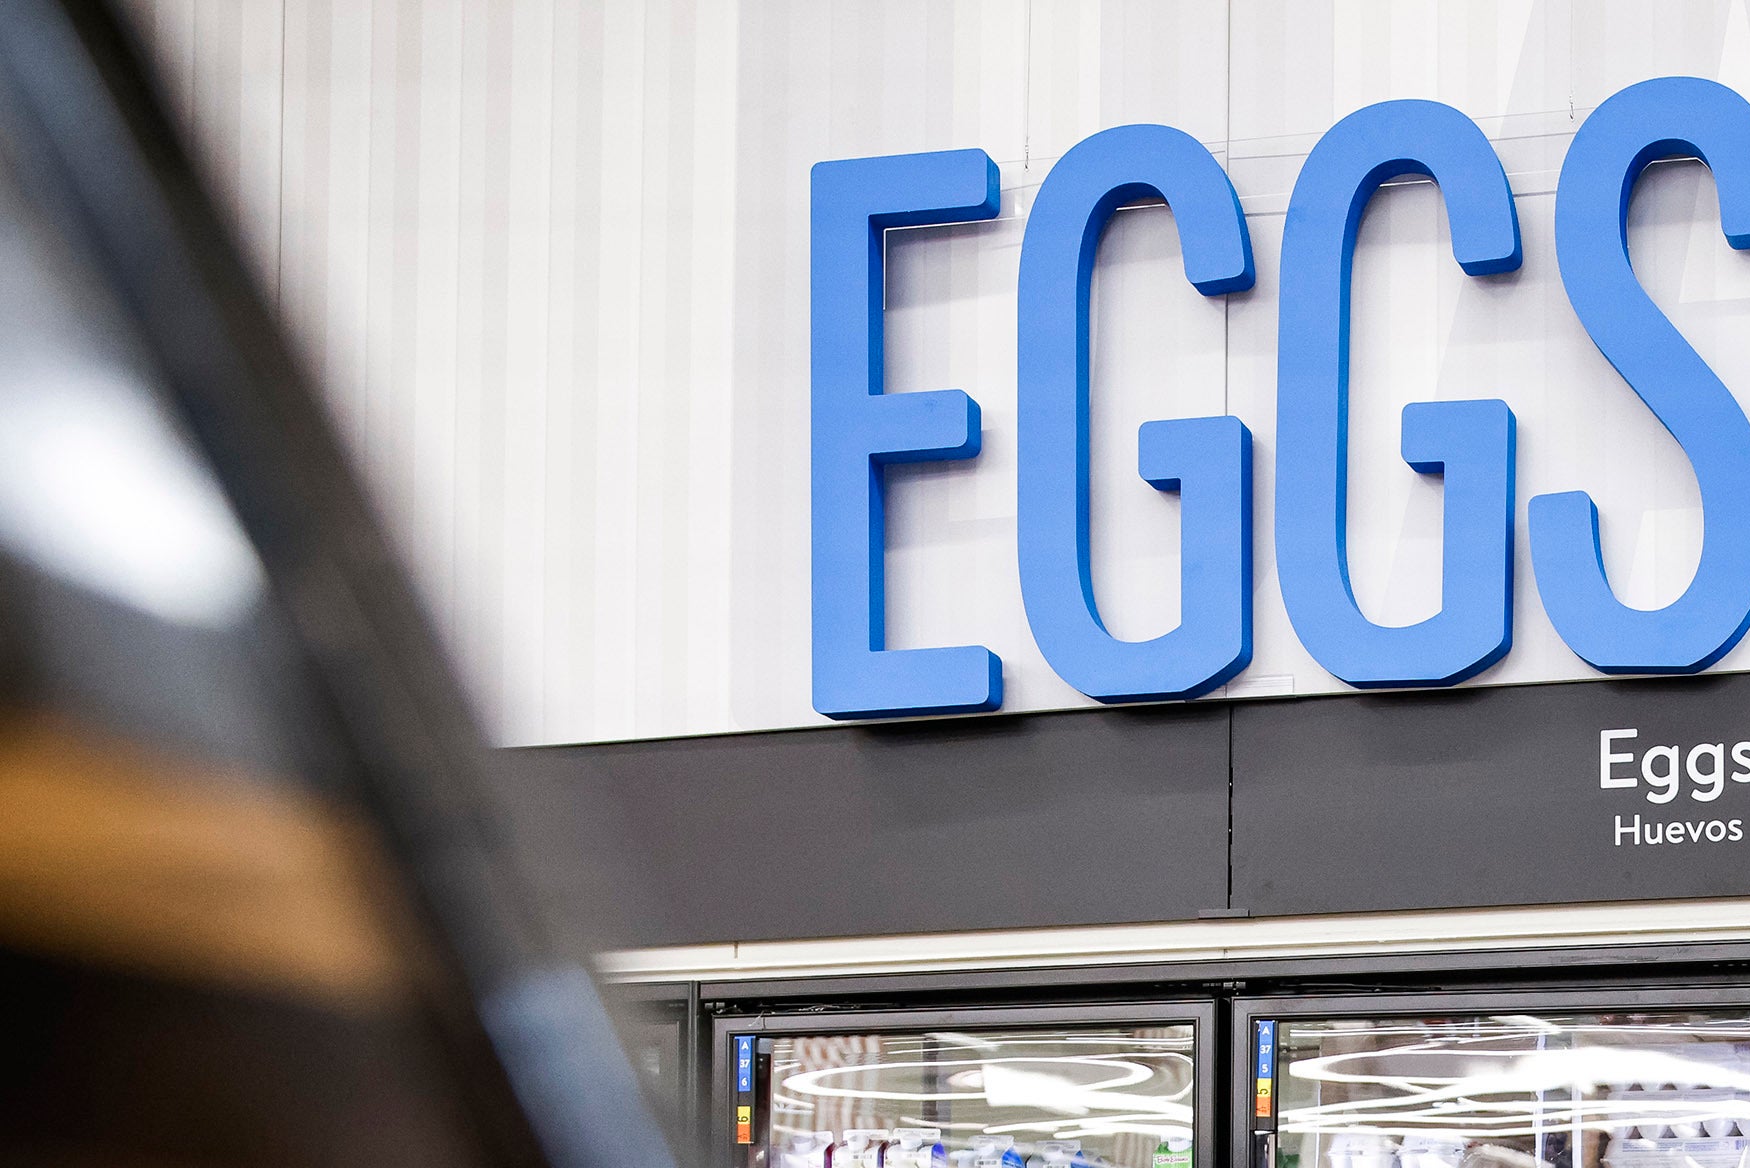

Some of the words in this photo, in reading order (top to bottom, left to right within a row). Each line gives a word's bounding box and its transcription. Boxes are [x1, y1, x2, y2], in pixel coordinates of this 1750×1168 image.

[1614, 814, 1743, 846] Huevos
[1262, 1026, 1270, 1035] A
[741, 1041, 749, 1050] A
[1260, 1045, 1271, 1054] 37
[740, 1059, 750, 1068] 37
[1262, 1064, 1268, 1073] 5
[741, 1077, 748, 1086] 6
